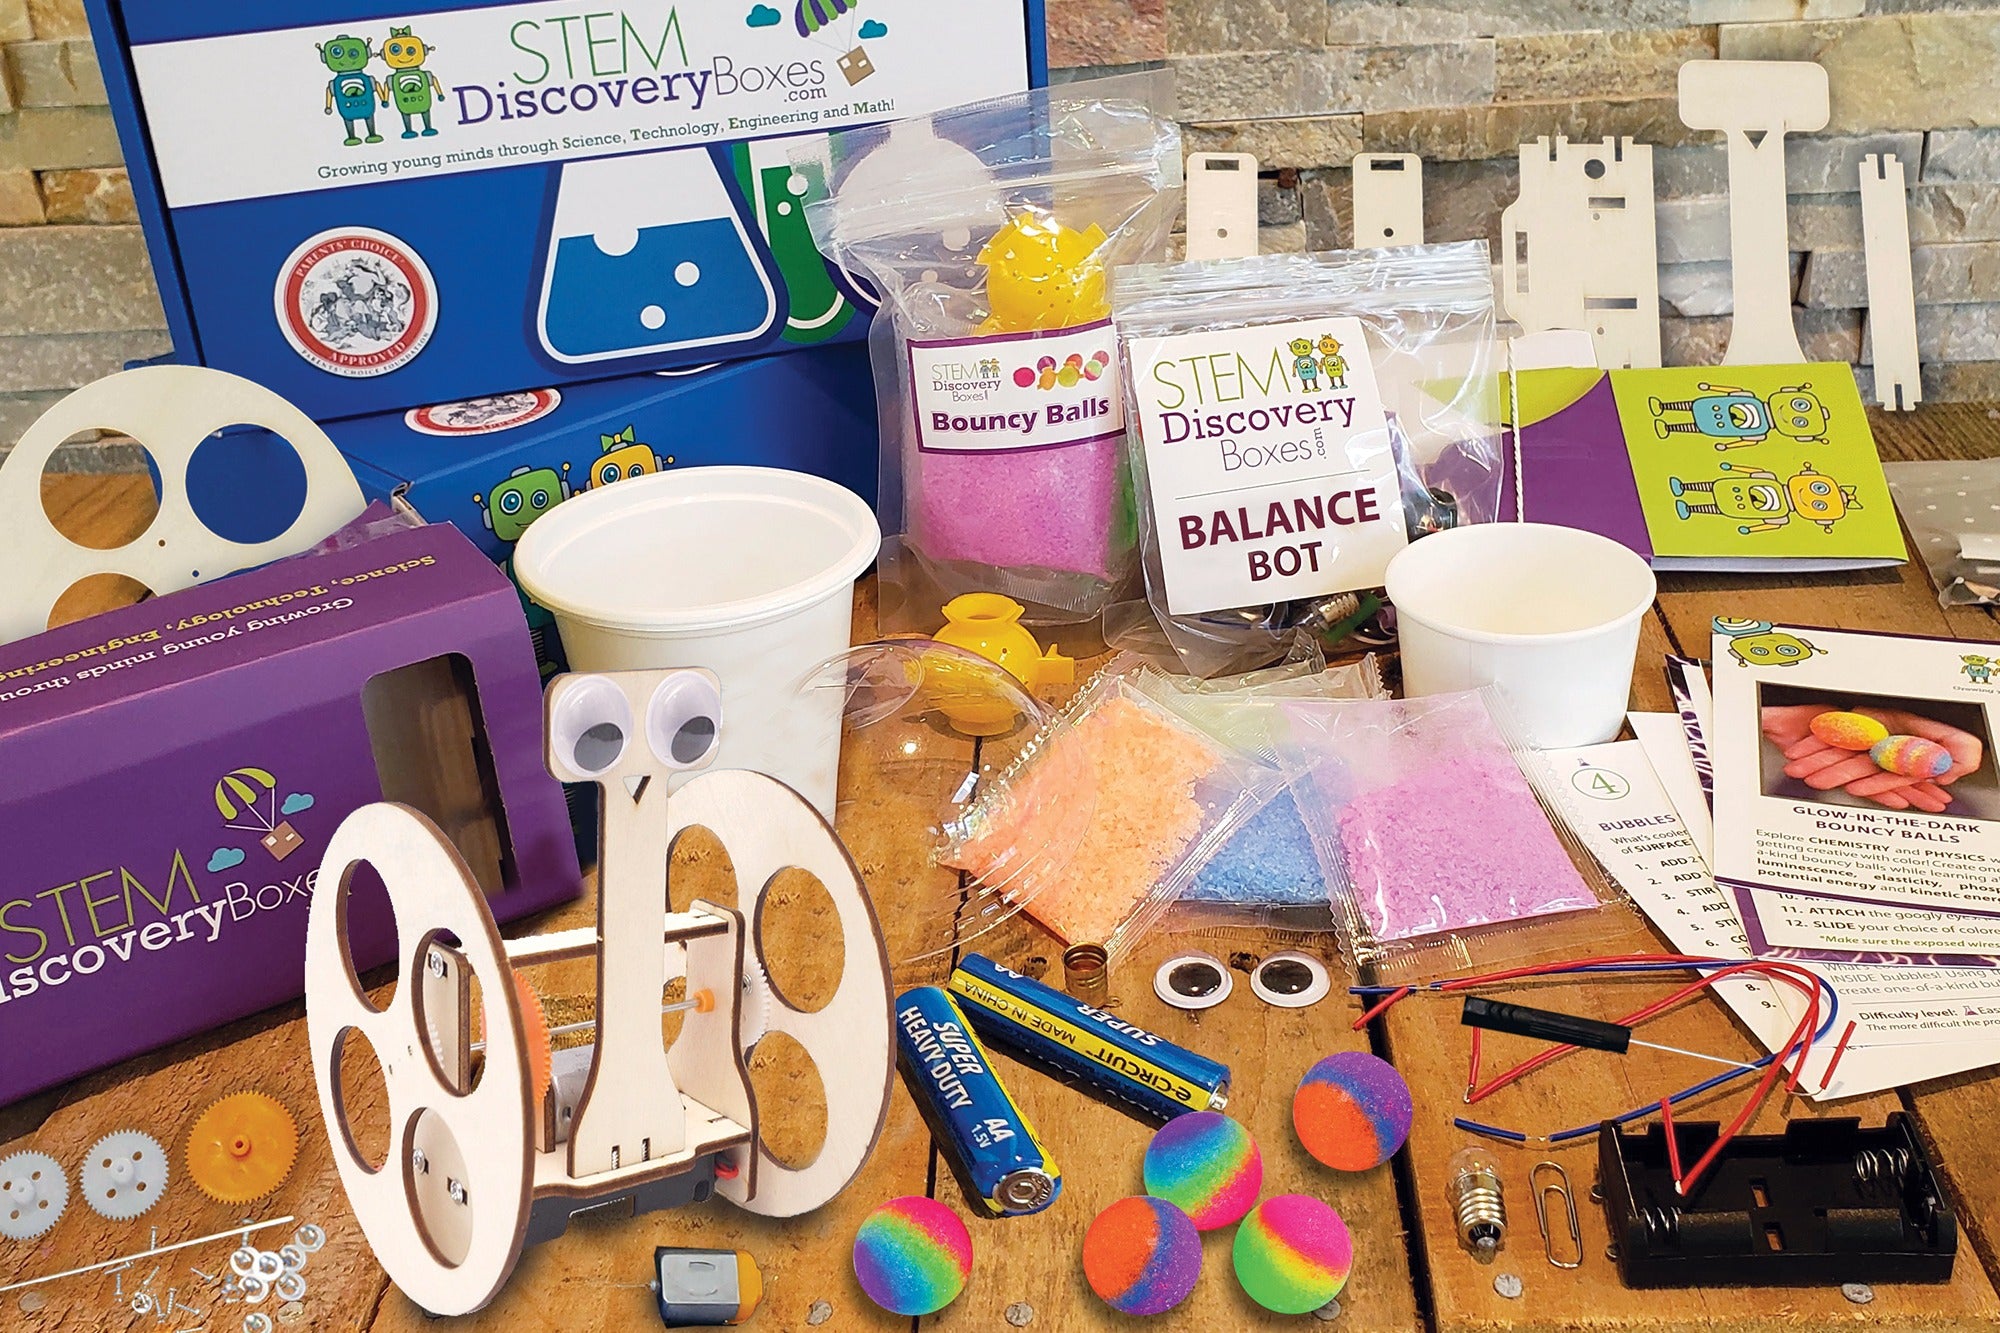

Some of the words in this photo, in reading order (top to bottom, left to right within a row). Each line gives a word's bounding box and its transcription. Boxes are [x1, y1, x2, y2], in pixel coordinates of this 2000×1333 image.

[510, 5, 688, 84] STEM
[784, 86, 828, 103] .com
[317, 159, 388, 179] Growing
[394, 155, 443, 173] young
[446, 143, 495, 164] minds
[498, 139, 559, 158] through
[562, 134, 627, 150] Science,
[630, 121, 725, 142] Technology,
[728, 110, 819, 130] Engineering
[823, 104, 851, 119] and
[853, 99, 895, 115] Math!
[329, 341, 407, 366] APPROVED
[931, 362, 979, 381] STEM
[1153, 346, 1291, 409] STEM
[932, 380, 1002, 392] Discovery
[932, 411, 1038, 434] Bouncy
[1046, 397, 1110, 425] Balls
[1159, 396, 1356, 444] Discovery
[1220, 438, 1312, 471] Boxes
[1313, 427, 1328, 459] .com
[1178, 487, 1381, 550] BALANCE
[330, 554, 437, 588] Science,
[1247, 541, 1323, 582] BOT
[166, 584, 330, 631] Technology,
[248, 597, 355, 633] Growing
[162, 628, 242, 658] young
[76, 651, 157, 680] minds
[1591, 773, 1621, 794] 4
[1598, 814, 1676, 832] BUBBLES
[1793, 806, 1982, 834] GLOW-IN-THE-DARK
[1815, 820, 1896, 837] BOUNCY
[1901, 830, 1961, 844] BALLS
[1610, 834, 1651, 845] What's
[1621, 846, 1634, 855] of
[1634, 839, 1692, 853] SURFACE
[1756, 828, 1805, 841] Explore
[1808, 836, 1890, 852] CHEMISTRY
[1895, 847, 1920, 856] and
[1924, 849, 1986, 862] PHYSICS
[1635, 863, 1649, 871] 1.
[1660, 857, 1688, 868] ADD
[1756, 839, 1804, 853] getting
[1806, 846, 1858, 858] creative
[1860, 853, 1890, 862] with
[1932, 860, 1976, 871] Create
[1756, 848, 1798, 861] a-kind
[1801, 854, 1852, 869] bouncy
[1855, 861, 1886, 872] balls
[1890, 866, 1927, 876] while
[1930, 869, 1987, 884] learning
[1647, 878, 1662, 886] 2.
[1673, 871, 1702, 882] ADD
[1757, 857, 1858, 878] luminescence,
[1873, 873, 1943, 888] elasticity,
[1757, 868, 1823, 884] potential
[1826, 878, 1877, 891] energy
[1880, 884, 1907, 893] and
[1909, 886, 1961, 899] kinetic
[0, 848, 201, 964] STEM
[1661, 893, 1676, 901] 3.
[1686, 886, 1716, 898] STIR
[1676, 908, 1691, 916] 4.
[1702, 902, 1730, 913] ADD
[1781, 905, 1804, 914] 11.
[1809, 906, 1866, 917] ATTACH
[1868, 910, 1892, 918] the
[1895, 911, 1942, 920] googly
[1690, 924, 1705, 932] 5.
[1785, 919, 1809, 928] 12.
[1813, 920, 1856, 930] SLIDE
[1858, 923, 1890, 932] your
[1893, 924, 1938, 933] choice
[1941, 925, 1956, 933] of
[1705, 939, 1720, 947] 6.
[1890, 938, 1911, 946] the
[1913, 940, 1965, 948] exposed
[1745, 983, 1761, 992] 8.
[1830, 973, 1877, 983] INSIDE
[1881, 970, 1942, 982] bubbles!
[1945, 968, 1988, 979] Using
[1838, 986, 1880, 996] create
[1884, 980, 1979, 994] one-of-a-kind
[1979, 979, 2000, 989] bu
[964, 980, 1009, 1011] CHINA
[1761, 1000, 1777, 1009] 9.
[1011, 1006, 1028, 1021] IN
[1077, 1004, 1164, 1046] SUPER
[1858, 1009, 1919, 1021] Difficulty
[1921, 1008, 1958, 1018] level:
[1865, 1023, 1888, 1032] The
[1888, 1023, 1918, 1031] more
[1919, 1020, 1961, 1030] difficult
[1962, 1019, 1982, 1028] the
[1030, 1015, 1076, 1045] MADE
[899, 1006, 946, 1063] HEAVY
[930, 1061, 974, 1110] DUTY
[933, 1022, 984, 1075] SUPER
[971, 1123, 993, 1148] 1.5V
[983, 1118, 1016, 1143] AA
